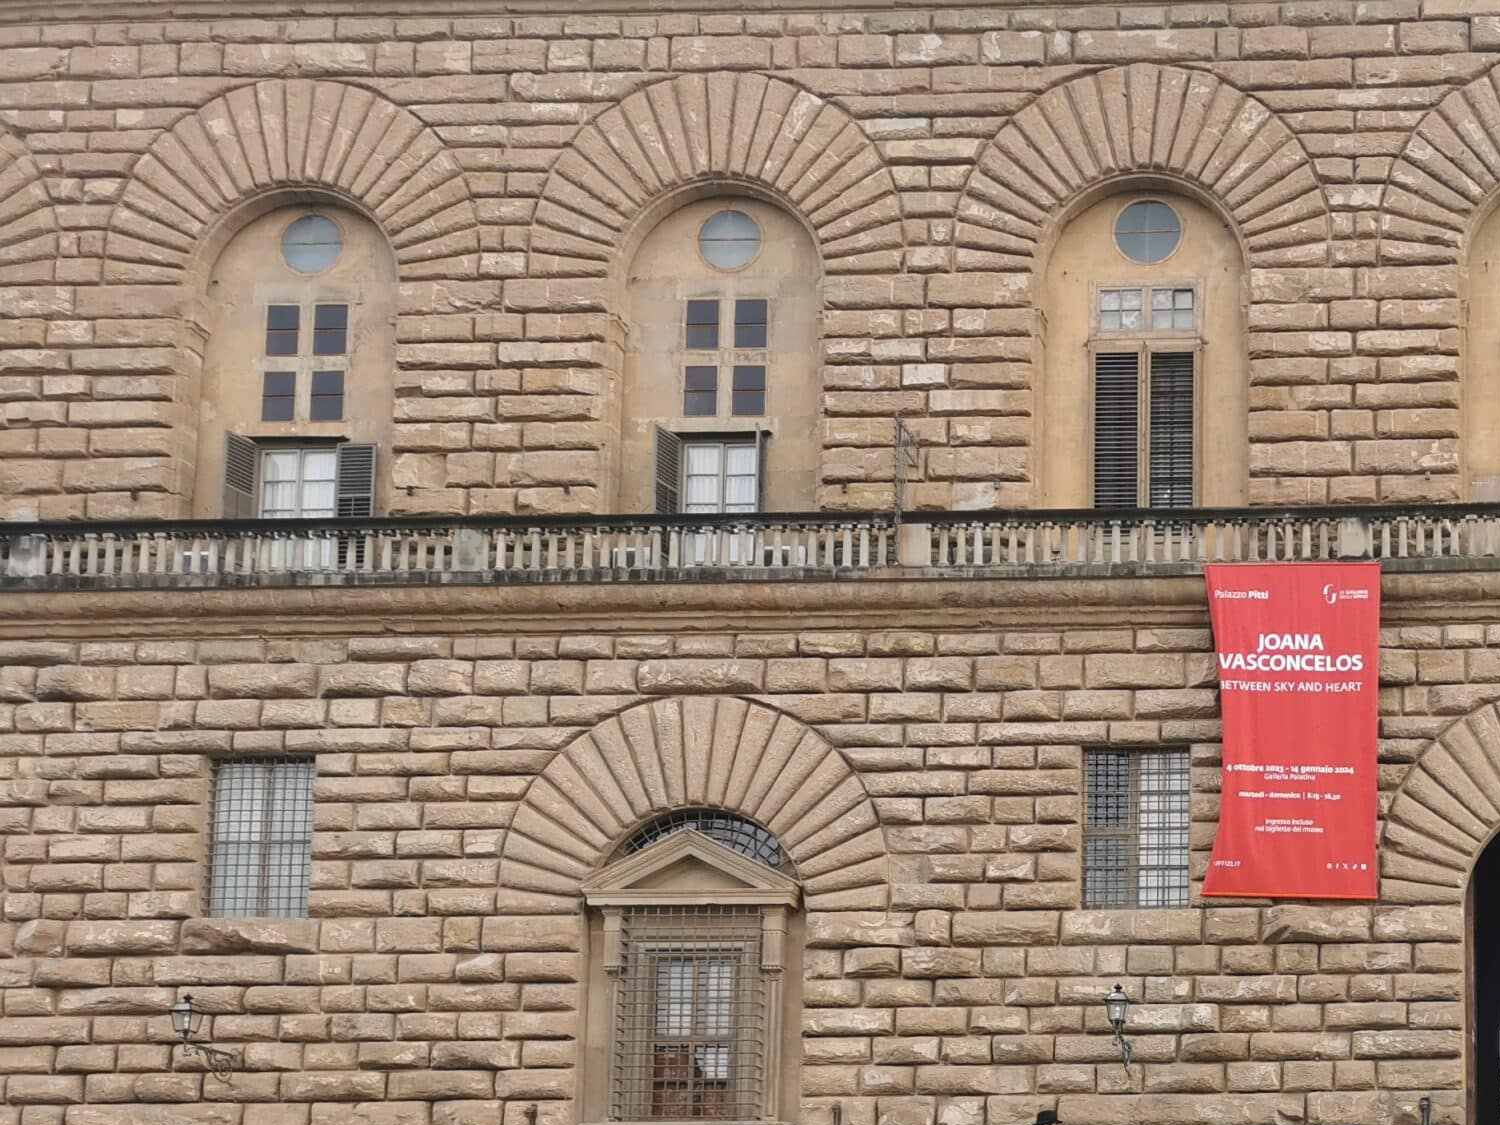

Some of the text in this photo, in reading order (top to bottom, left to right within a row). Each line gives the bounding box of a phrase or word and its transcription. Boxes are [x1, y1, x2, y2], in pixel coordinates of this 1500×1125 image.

[1215, 590, 1268, 599] Palazzo Pitti
[1257, 633, 1324, 652] JOANA
[1218, 653, 1364, 672] VASCONCELOS
[1274, 682, 1296, 692] SKY
[1297, 682, 1323, 692] AND
[1325, 682, 1363, 692] HEART
[1233, 763, 1265, 772] ottobre
[1265, 765, 1284, 774] 2023
[1300, 766, 1334, 775] gennaio
[1334, 767, 1354, 775] 2024
